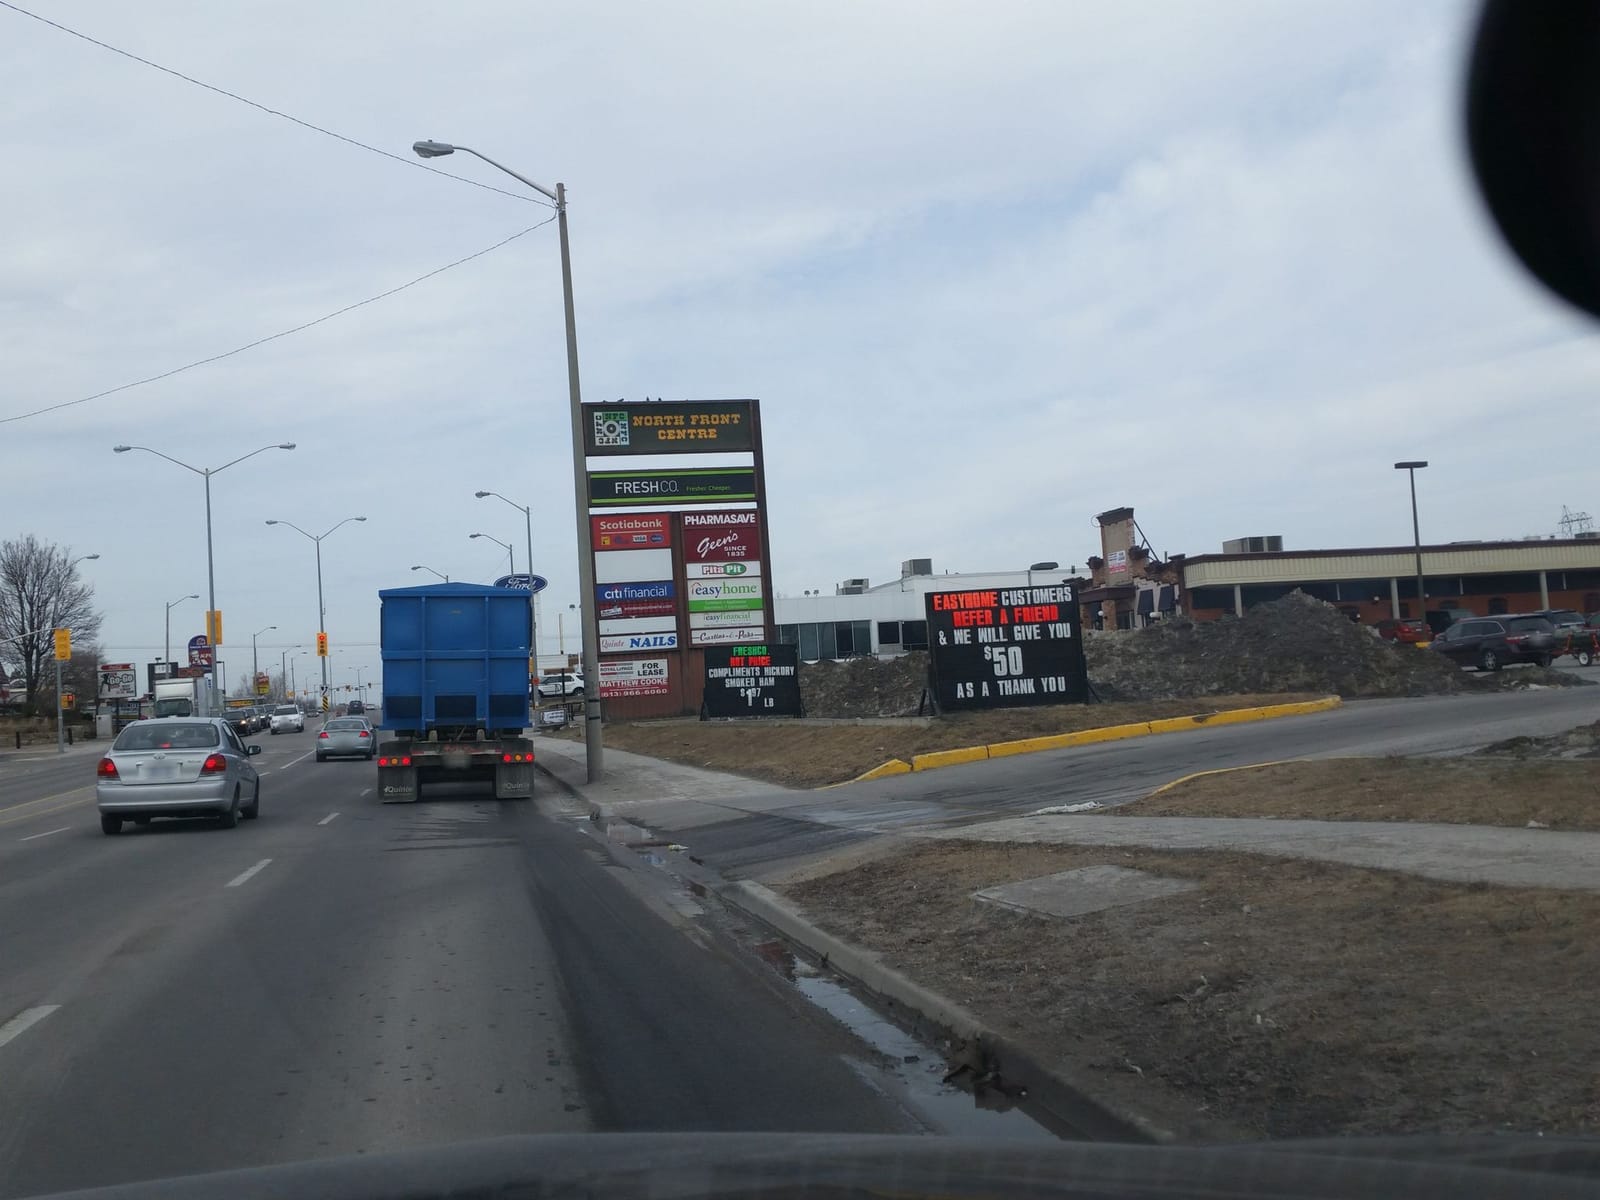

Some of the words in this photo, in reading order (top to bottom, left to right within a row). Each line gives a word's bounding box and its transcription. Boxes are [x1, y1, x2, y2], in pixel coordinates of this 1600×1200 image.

[633, 415, 684, 426] NORTH
[690, 414, 741, 425] FRONT
[658, 429, 717, 440] CENTRE
[600, 519, 663, 530] Scotiabank
[684, 513, 756, 525] PHARMASAVE
[697, 529, 738, 558] Geen's
[726, 564, 742, 573] Pit
[933, 591, 998, 611] EASYHOME
[1001, 587, 1072, 606] CUSTOMERS
[1000, 608, 1008, 624] A
[1014, 605, 1059, 623] FRIEND
[938, 630, 948, 646] &
[953, 629, 972, 644] WE
[978, 627, 1008, 643] WILL
[1014, 624, 1041, 641] GIVE
[1048, 622, 1071, 639] YOU
[630, 635, 676, 648] NAILS
[642, 662, 659, 670] FOR
[984, 645, 1024, 676] $50
[637, 669, 664, 677] LEASE
[708, 666, 760, 678] COMPLIMENTS
[764, 666, 795, 676] HICKORY
[600, 680, 638, 688] MATTHEW
[725, 677, 755, 688] SMOKED
[759, 677, 775, 686] HAM
[957, 682, 974, 699] AS
[982, 681, 990, 697] A
[997, 678, 1036, 696] THANK
[1041, 676, 1066, 693] YOU
[764, 698, 774, 707] LB
